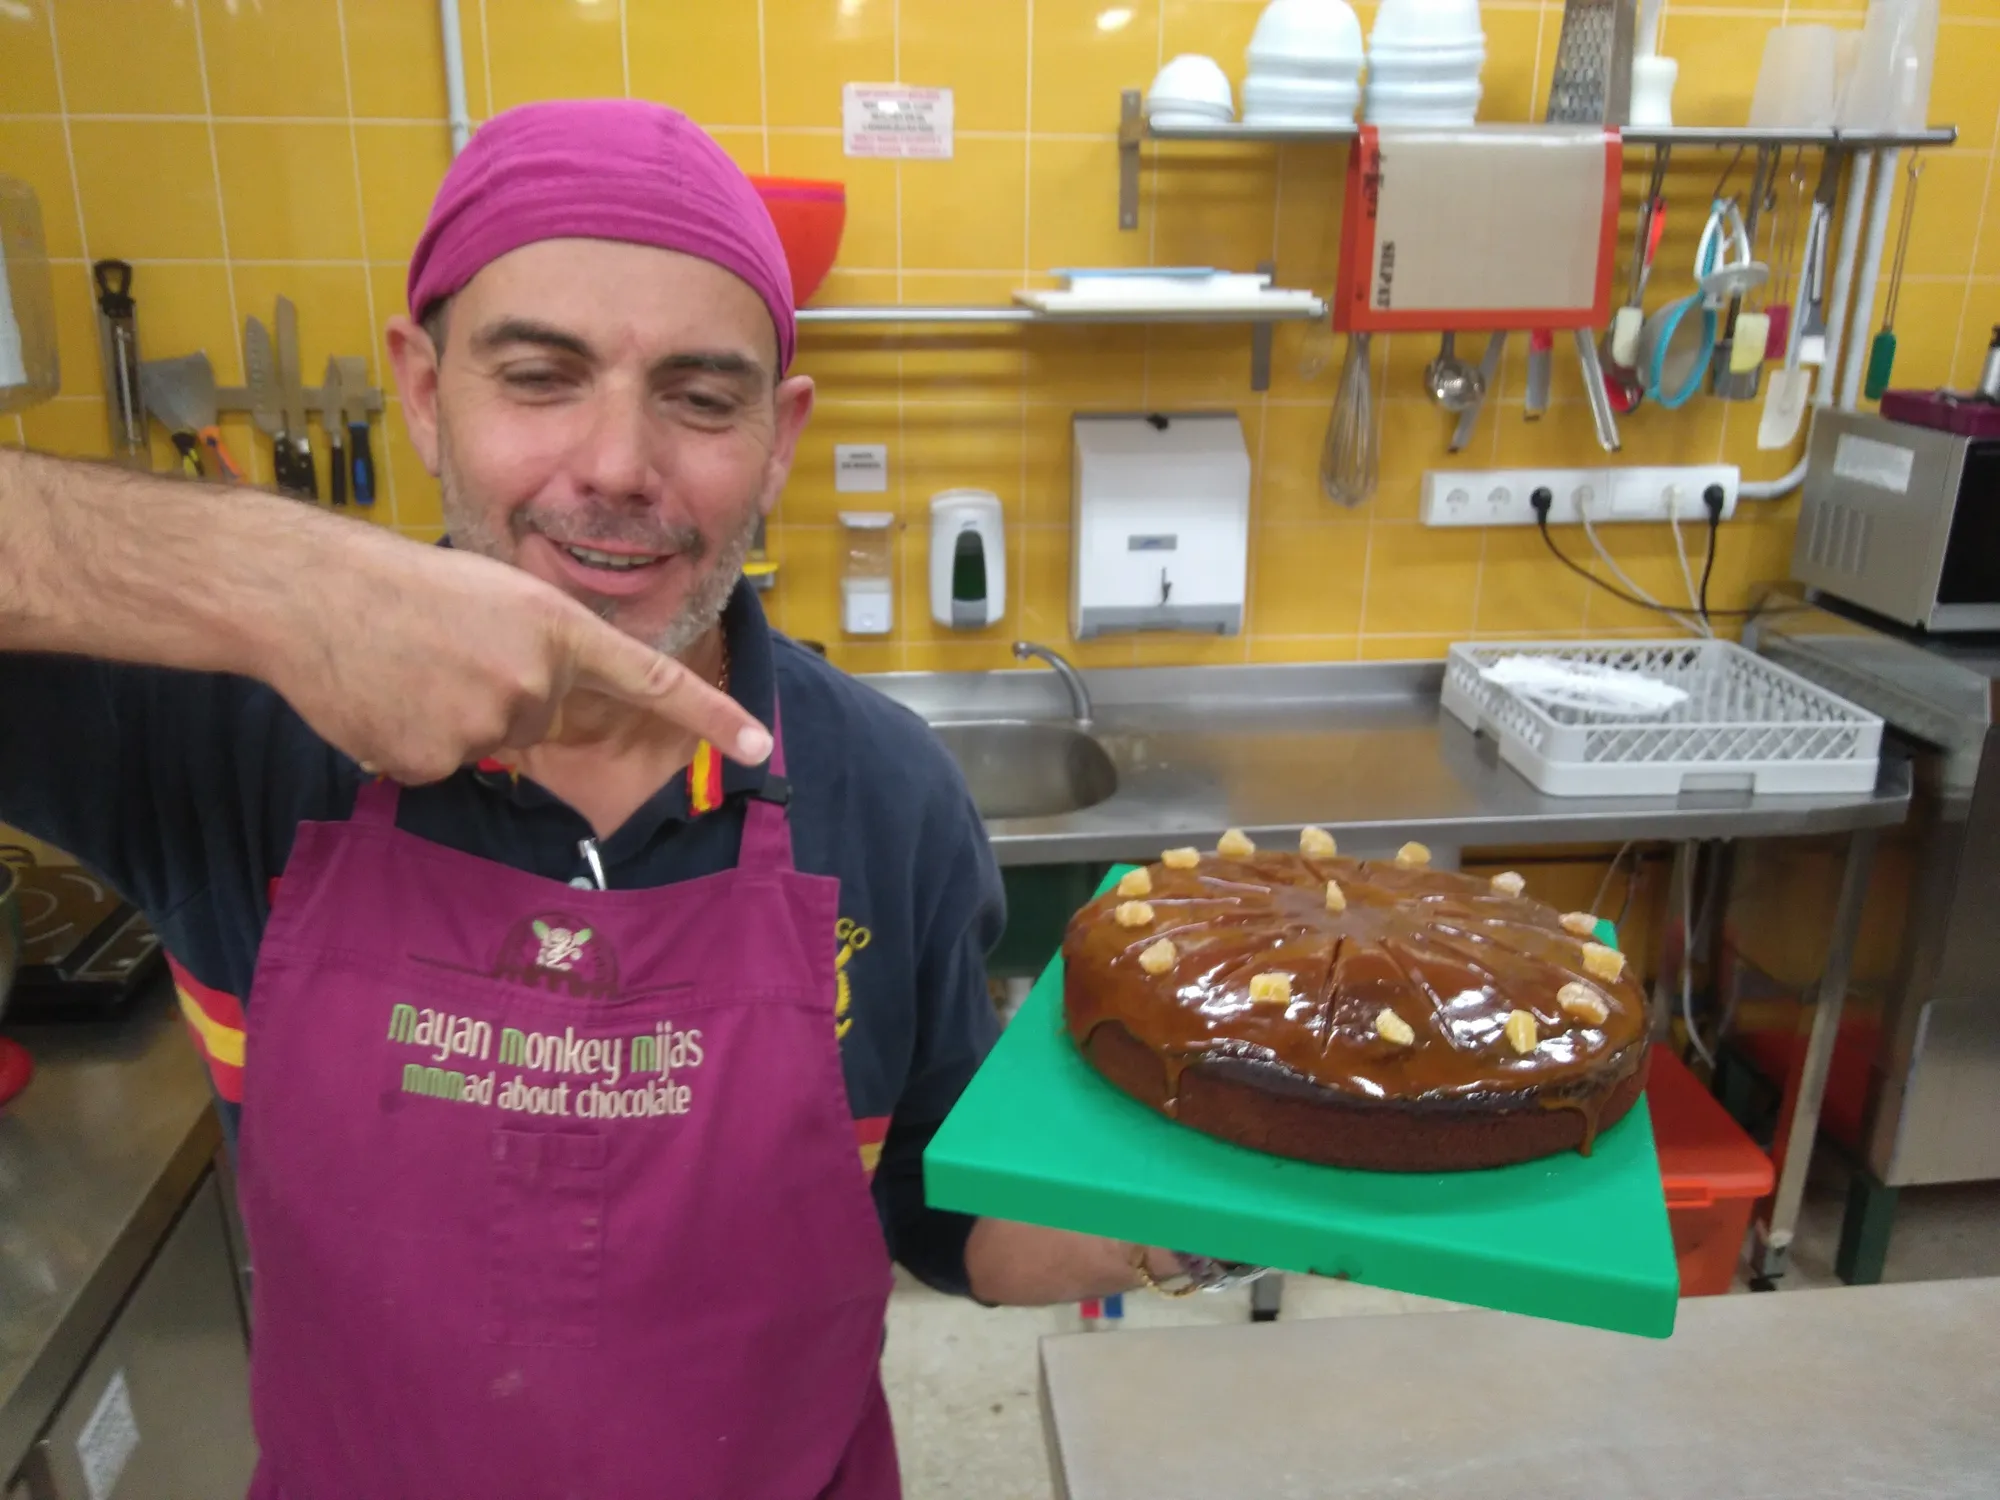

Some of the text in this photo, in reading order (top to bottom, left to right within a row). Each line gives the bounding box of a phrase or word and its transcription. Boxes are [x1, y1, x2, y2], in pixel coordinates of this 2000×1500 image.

[387, 1003, 704, 1085] mayan monkey mijas
[402, 1063, 692, 1119] mmmad about chocolate
